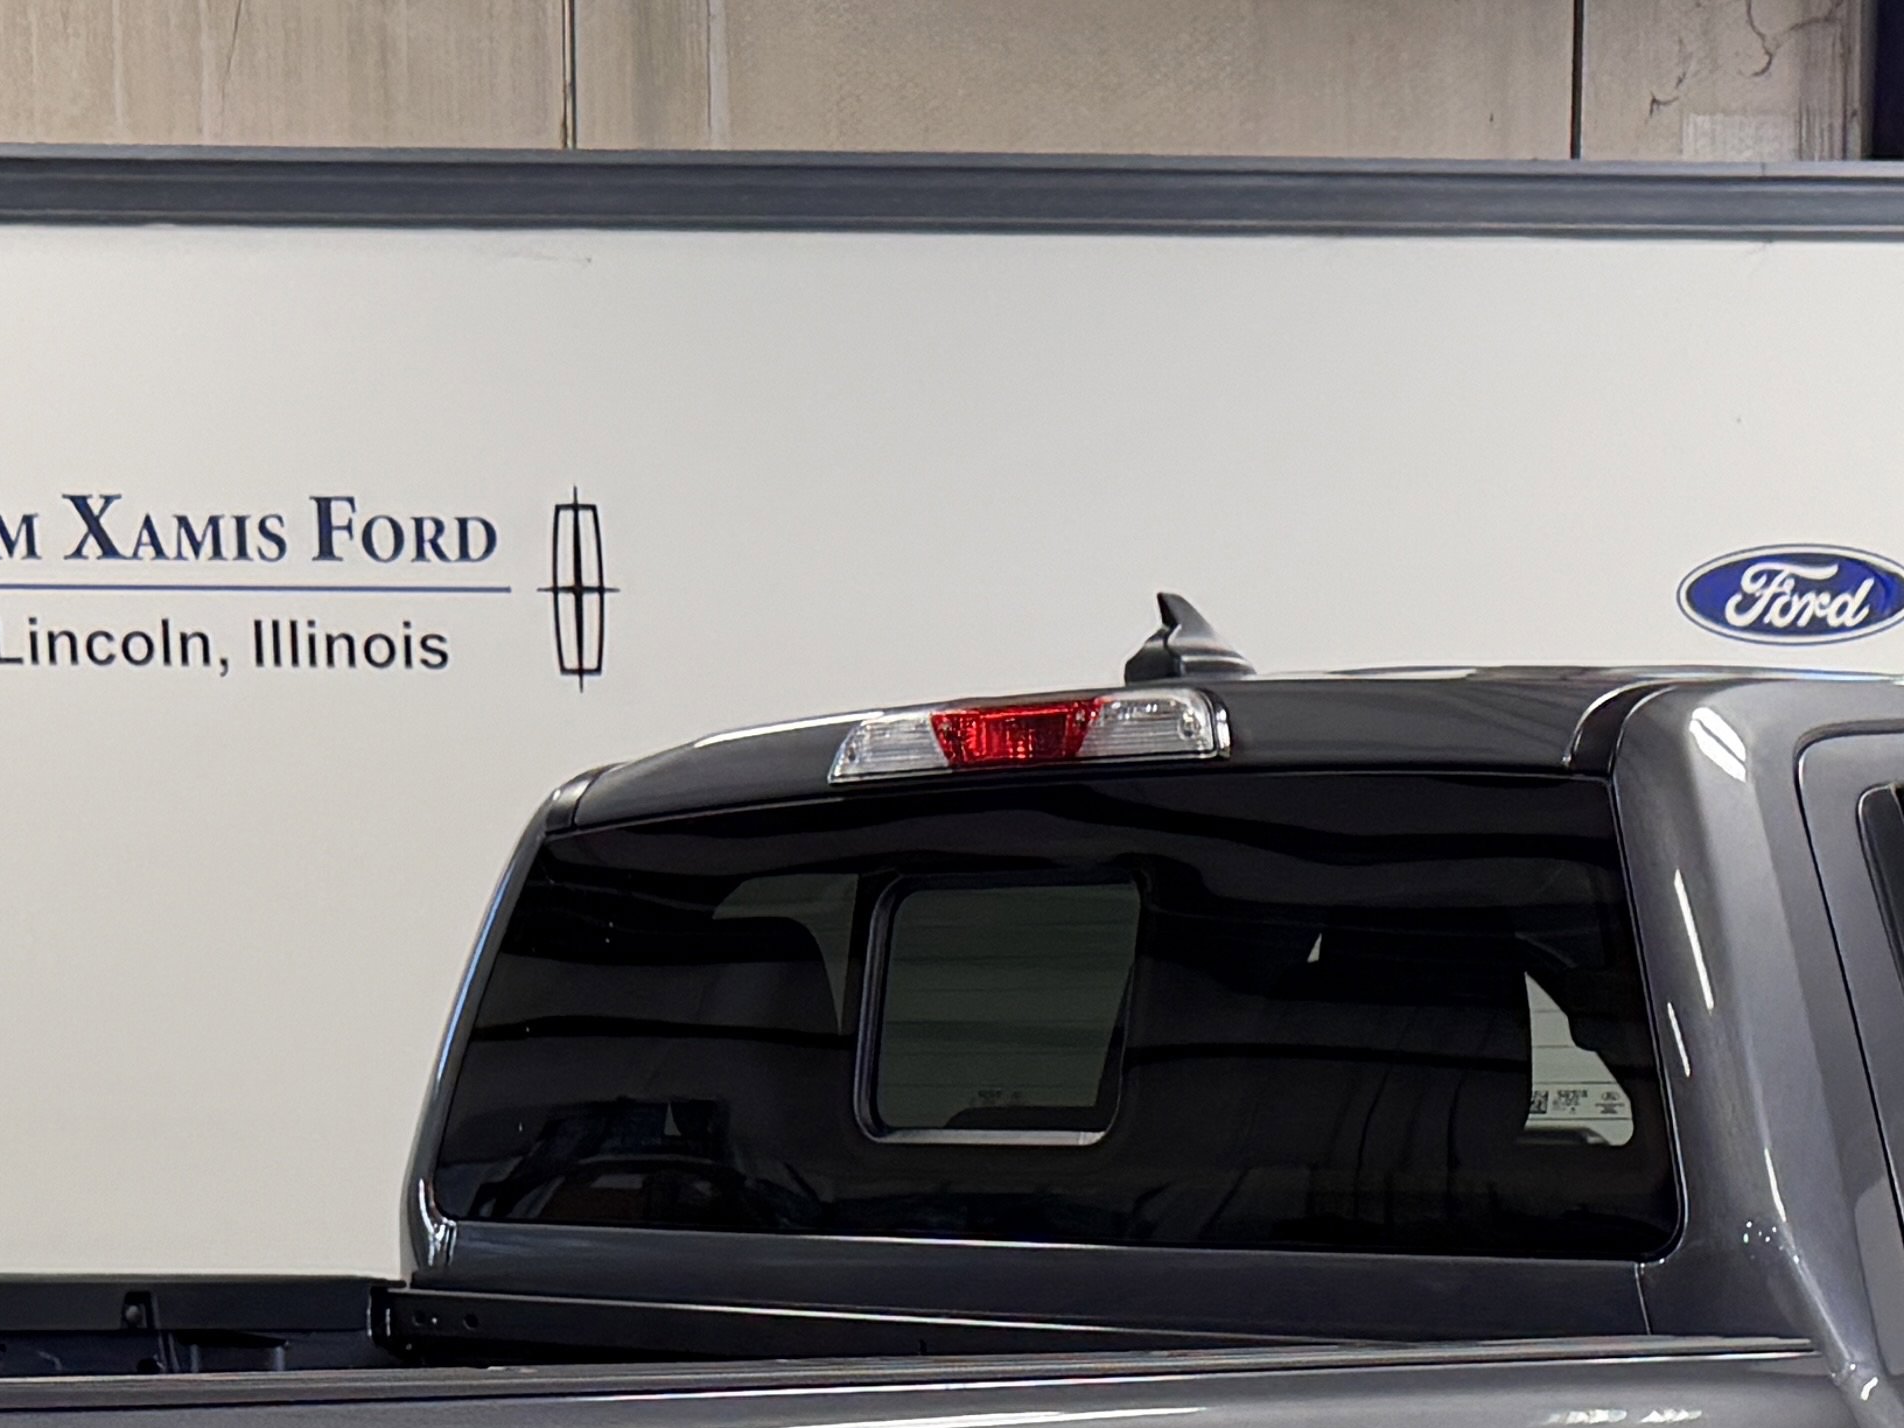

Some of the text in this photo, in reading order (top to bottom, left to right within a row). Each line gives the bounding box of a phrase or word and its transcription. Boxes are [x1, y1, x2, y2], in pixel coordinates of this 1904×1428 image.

[61, 493, 287, 563] XAMIS
[309, 494, 497, 564] FORD
[1725, 560, 1875, 628] Ford
[253, 618, 449, 670] Illinois
